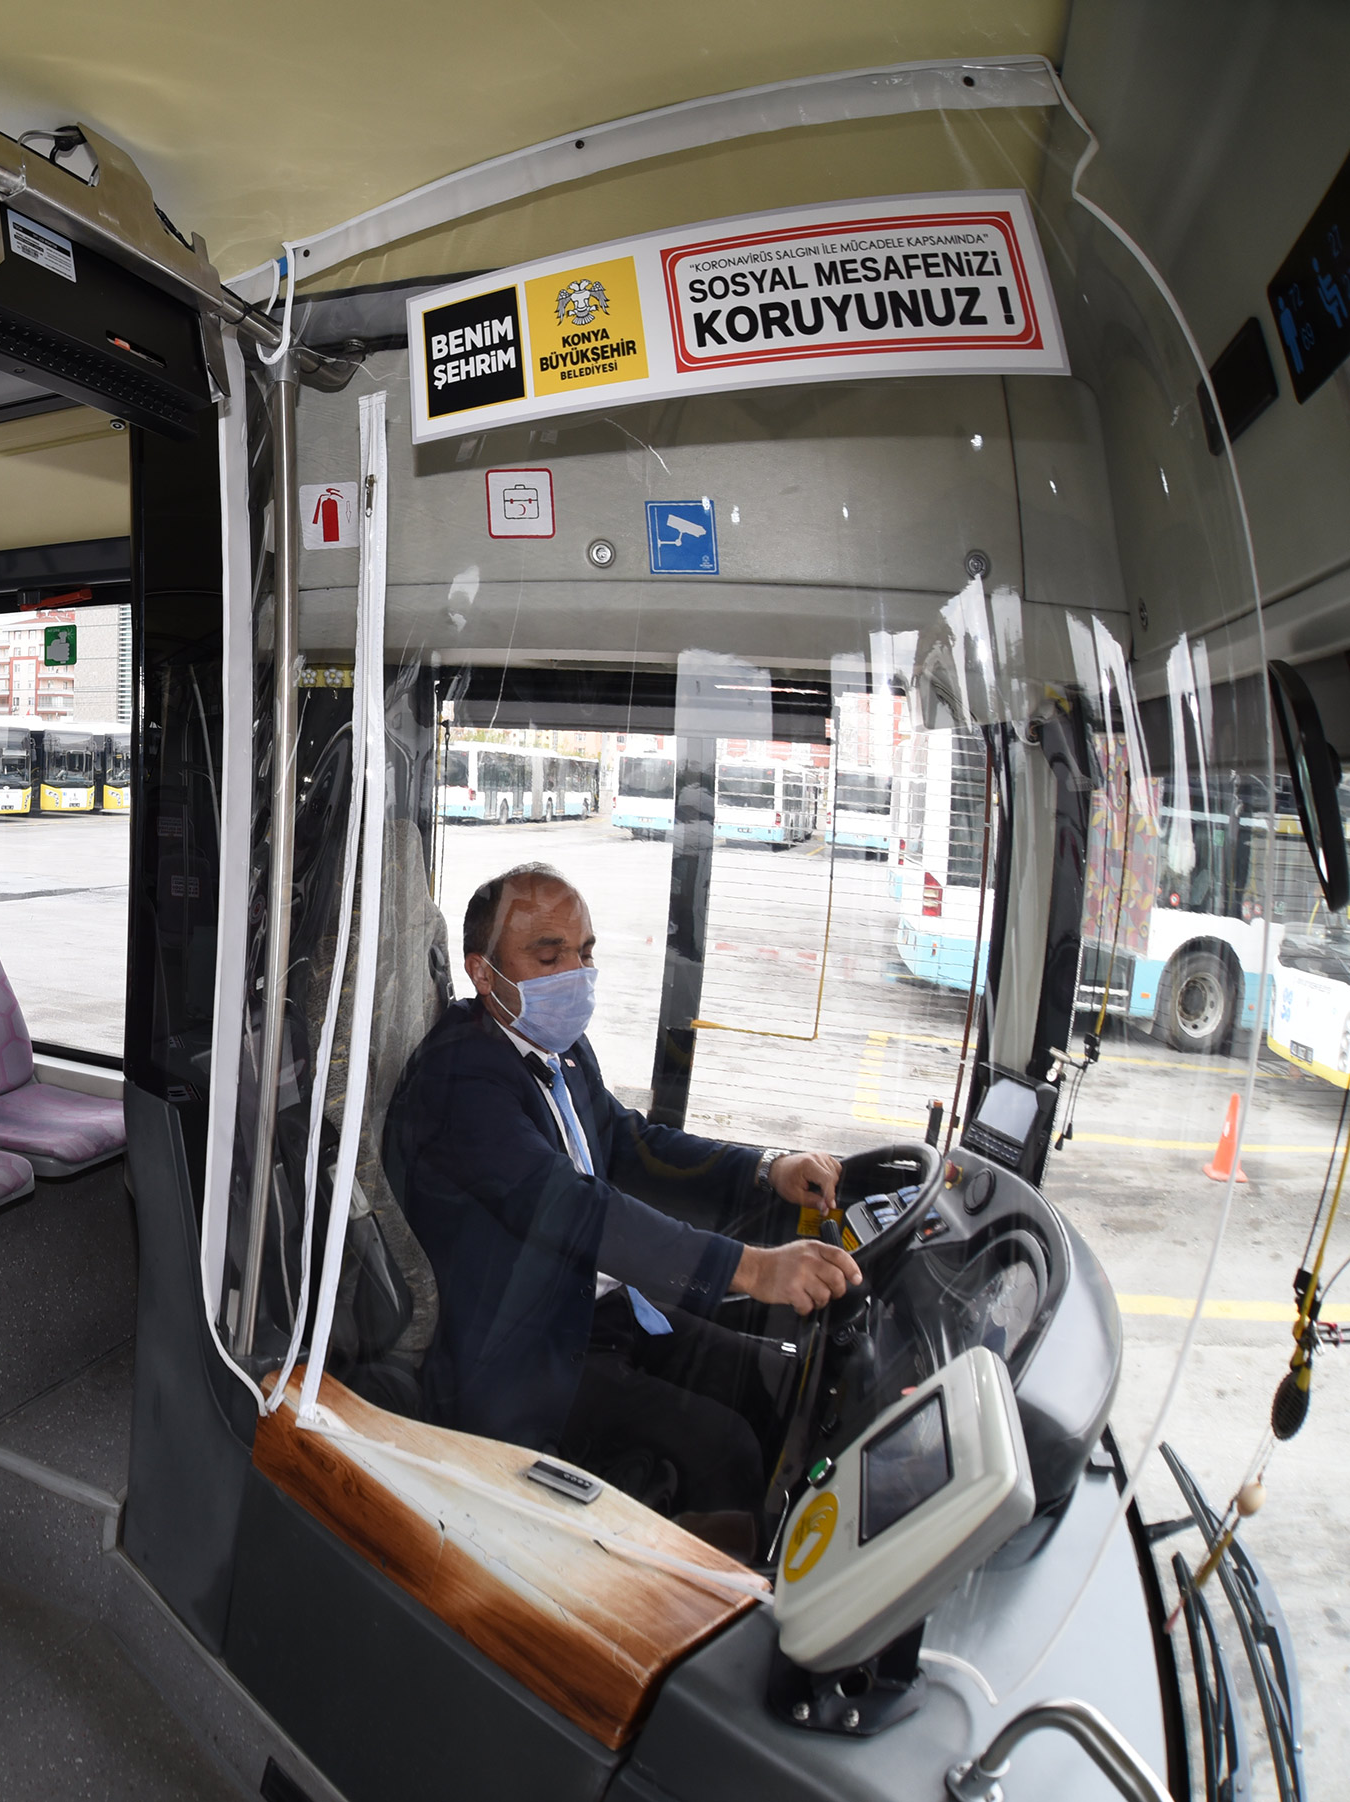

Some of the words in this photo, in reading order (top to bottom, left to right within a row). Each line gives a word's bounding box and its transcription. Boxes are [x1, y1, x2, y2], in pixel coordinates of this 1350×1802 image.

[776, 246, 821, 261] SALGINI
[821, 243, 838, 256] İLE
[840, 237, 905, 252] MÜCADELE
[688, 265, 809, 303] SOSYAL
[693, 287, 988, 348] KORUYUNUZ
[998, 286, 1016, 325] !
[561, 327, 610, 349] KONYA
[539, 338, 638, 372] BÜYÜKŞEHİR
[560, 359, 618, 381] BELEDİYESİ
